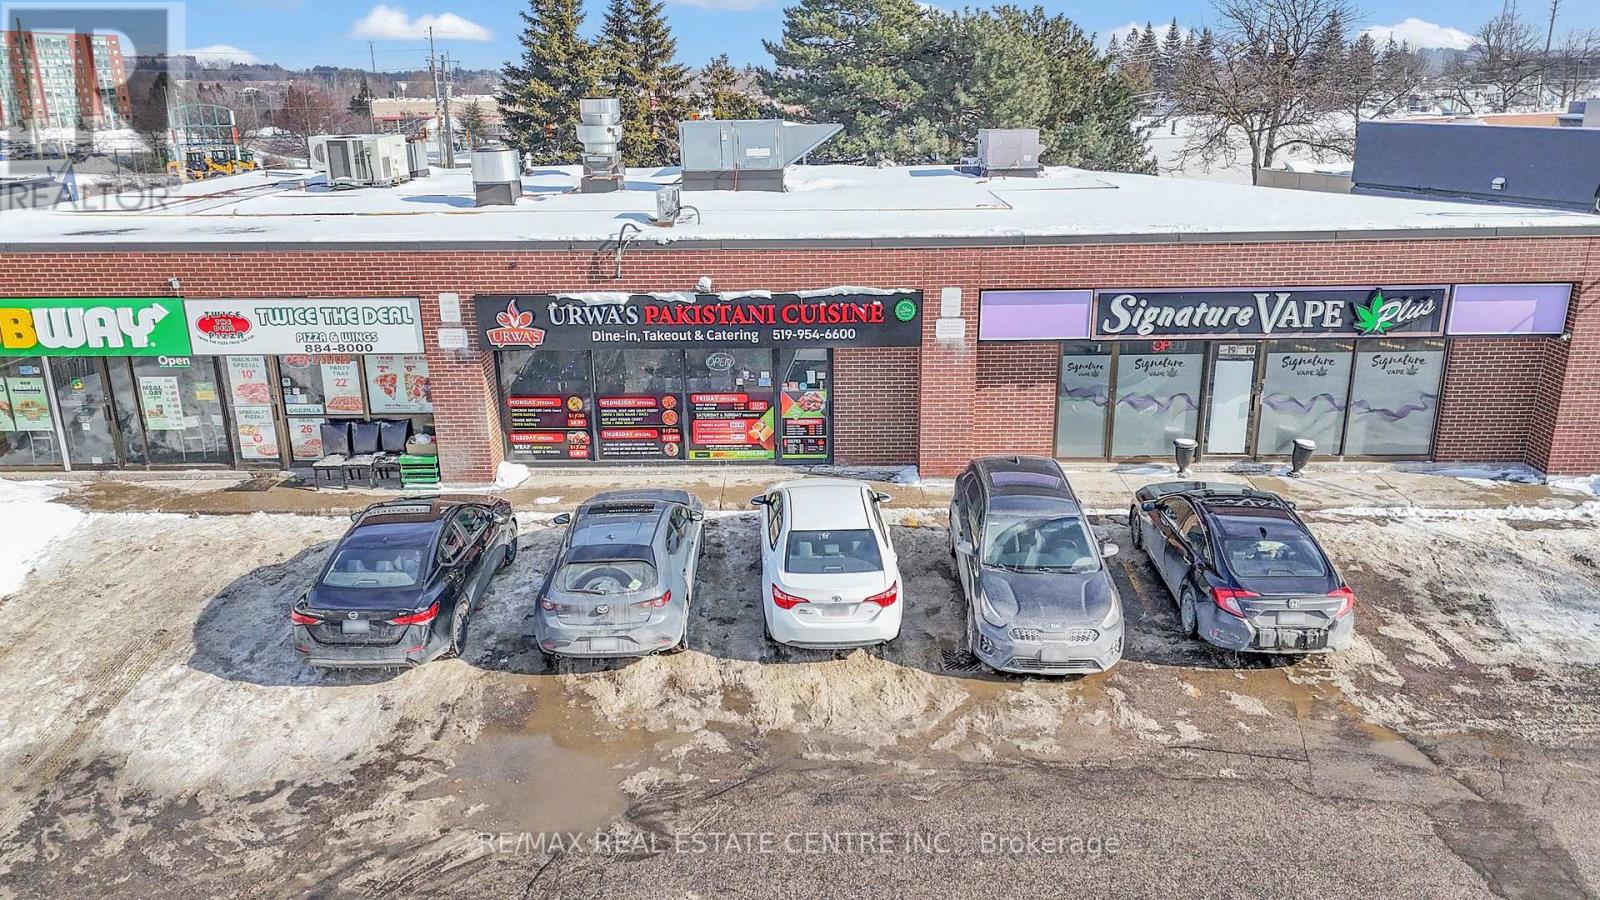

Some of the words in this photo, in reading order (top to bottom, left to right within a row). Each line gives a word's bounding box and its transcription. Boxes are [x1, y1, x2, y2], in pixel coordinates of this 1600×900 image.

[204, 311, 241, 319] TWICE
[255, 307, 317, 326] TWICE
[320, 307, 359, 325] THE
[362, 307, 414, 325] DEAL
[548, 303, 639, 325] URWA'S
[644, 304, 776, 325] PAKISTANI
[781, 303, 885, 325] CUISINE
[1102, 294, 1254, 335] Signature
[1253, 293, 1345, 333] VAPE
[1377, 298, 1436, 330] Plus
[0, 303, 169, 349] BWAY
[208, 331, 245, 340] PIZZA
[296, 332, 327, 342] PIZZA
[329, 332, 339, 342] &
[340, 332, 378, 342] WINGS
[493, 331, 541, 343] URWA'S
[592, 330, 640, 342] Dine-in,
[642, 330, 691, 341] Takeout
[694, 331, 704, 341] &
[706, 330, 759, 343] Catering
[772, 329, 856, 340] 519-954-6600
[305, 344, 373, 353] 884-8000
[158, 355, 191, 367] Open
[709, 357, 732, 366] OPEN
[1067, 361, 1104, 372] Signature
[1134, 357, 1185, 371] Signature
[1281, 354, 1337, 371] Signature
[1371, 353, 1427, 370] Signature
